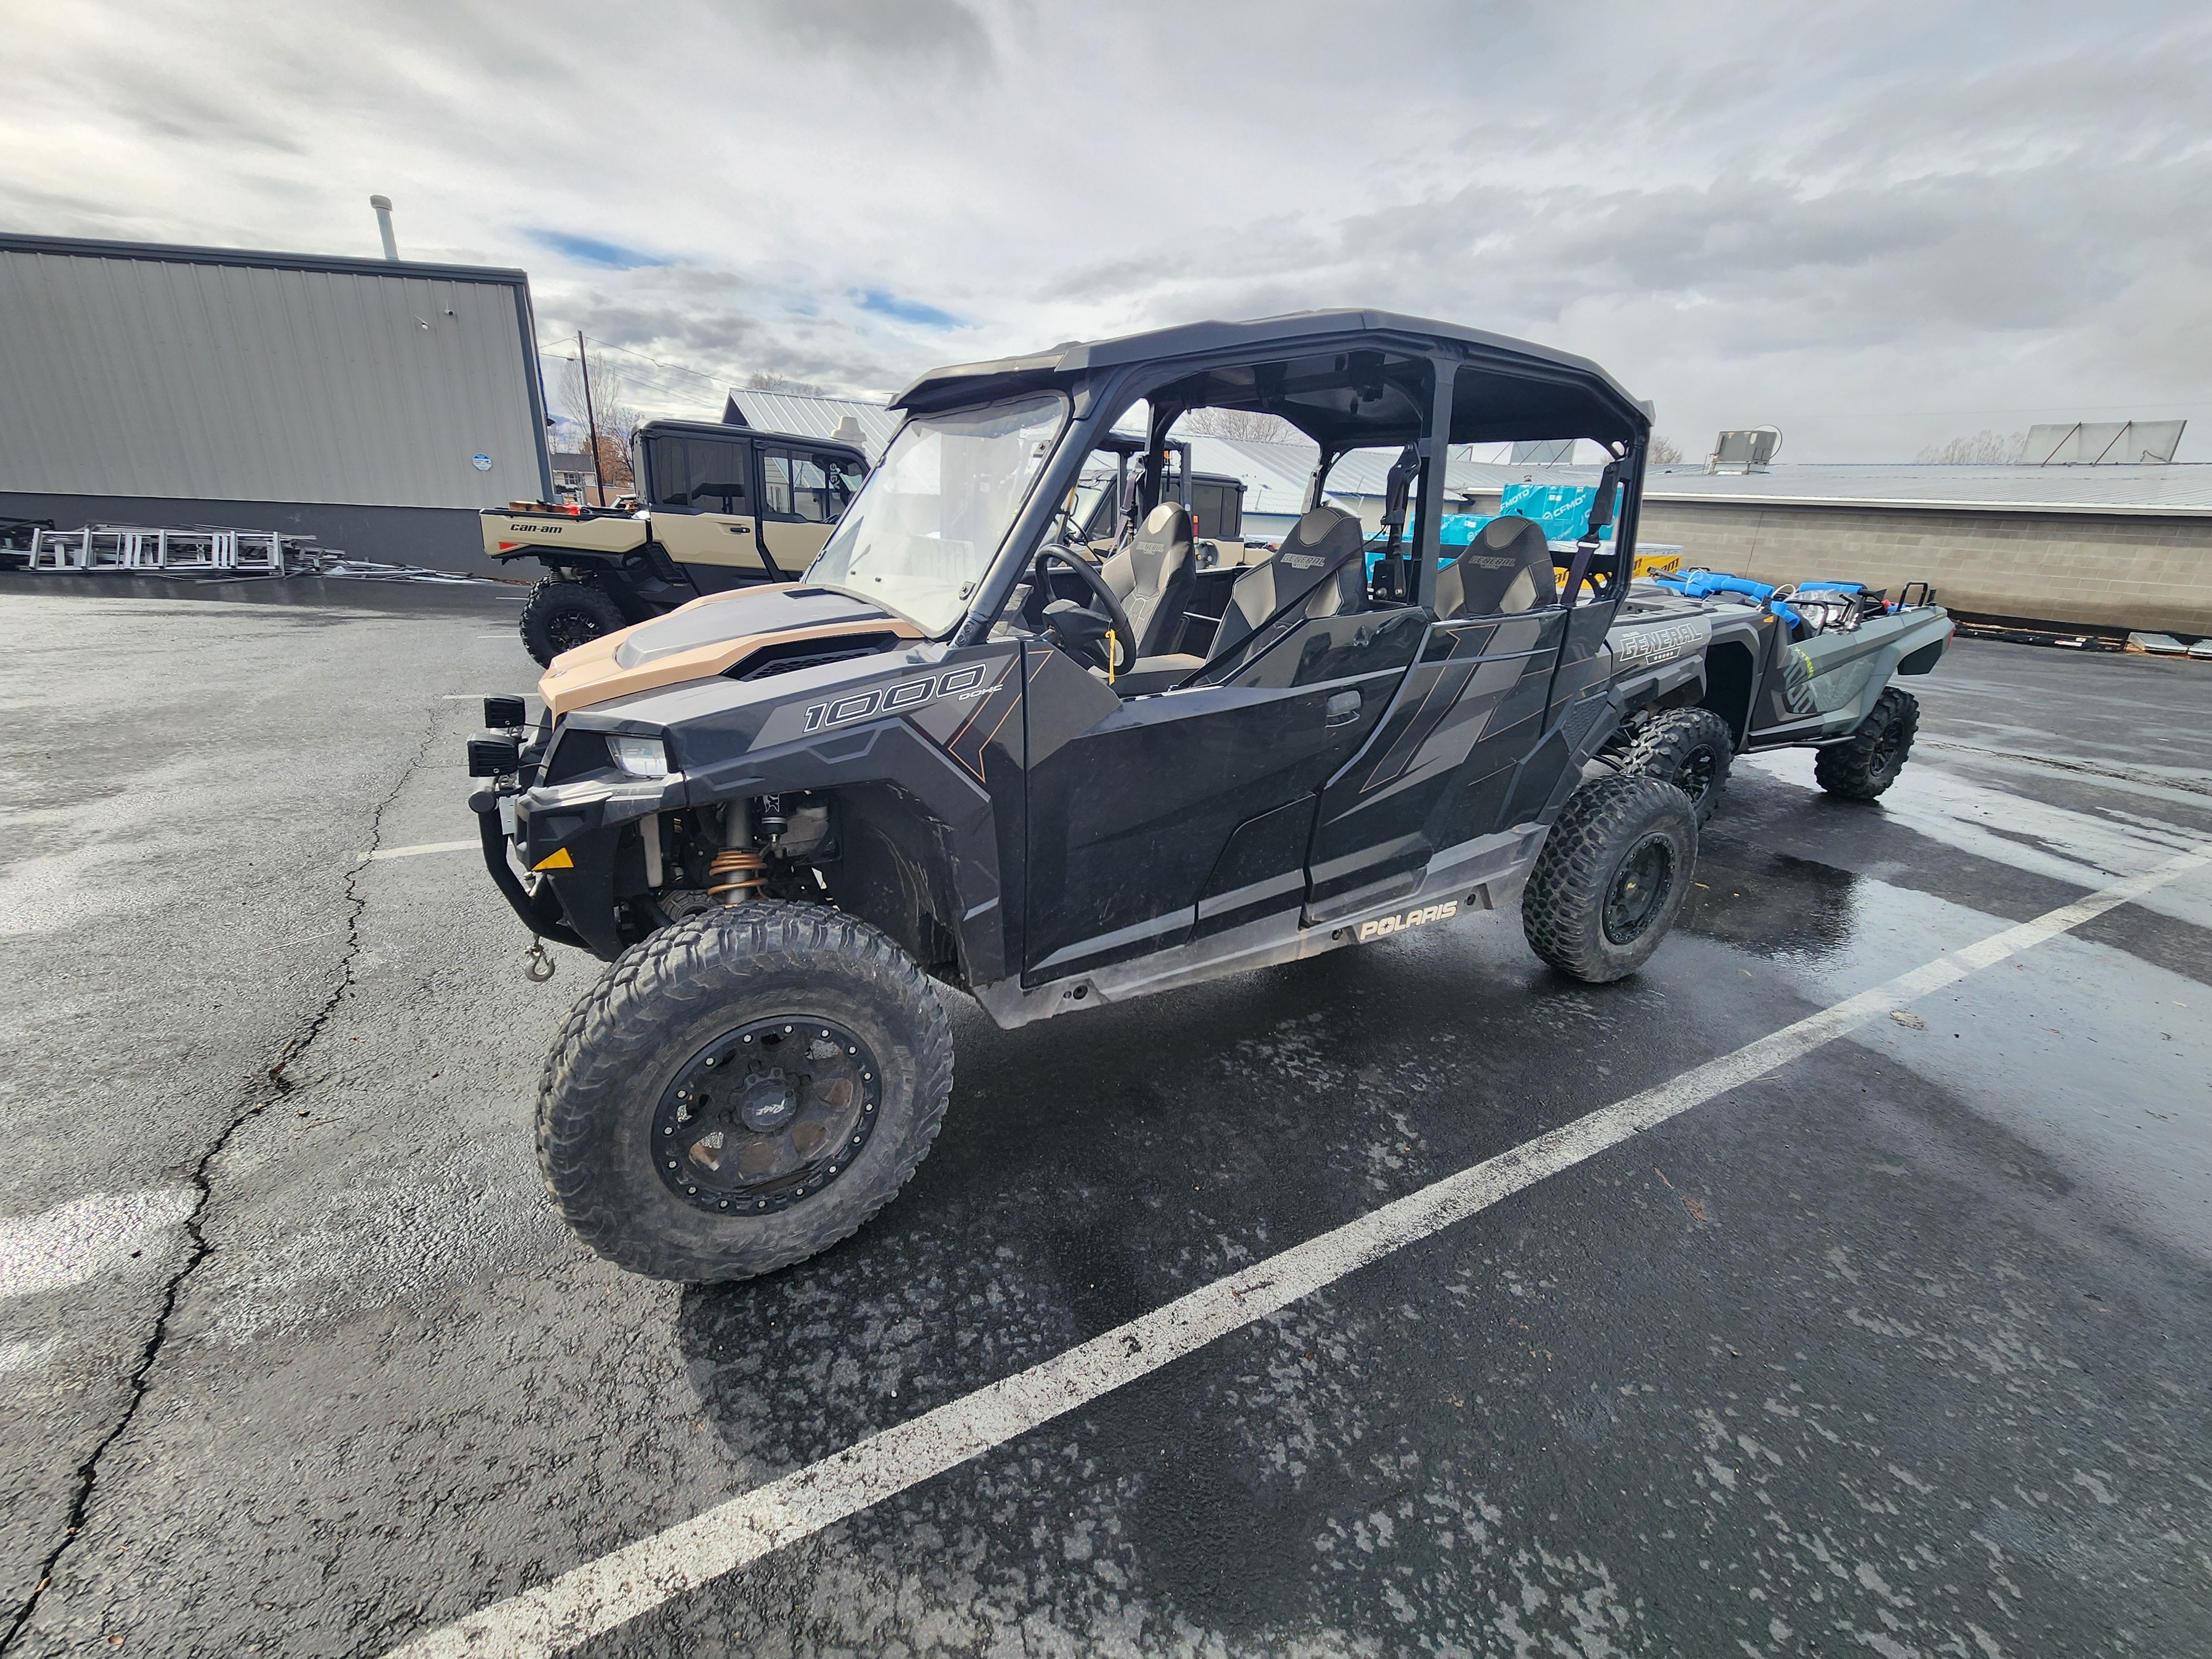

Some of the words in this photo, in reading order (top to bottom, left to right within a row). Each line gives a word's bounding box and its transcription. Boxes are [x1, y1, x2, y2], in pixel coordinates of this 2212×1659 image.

[510, 524, 562, 534] can-am
[1280, 554, 1325, 567] GENERAL
[1468, 556, 1516, 567] GENERAL
[1619, 623, 1703, 662] GENERAL
[803, 664, 987, 733] 1000
[958, 684, 1004, 701] DOHC
[1359, 900, 1458, 941] POLARIS
